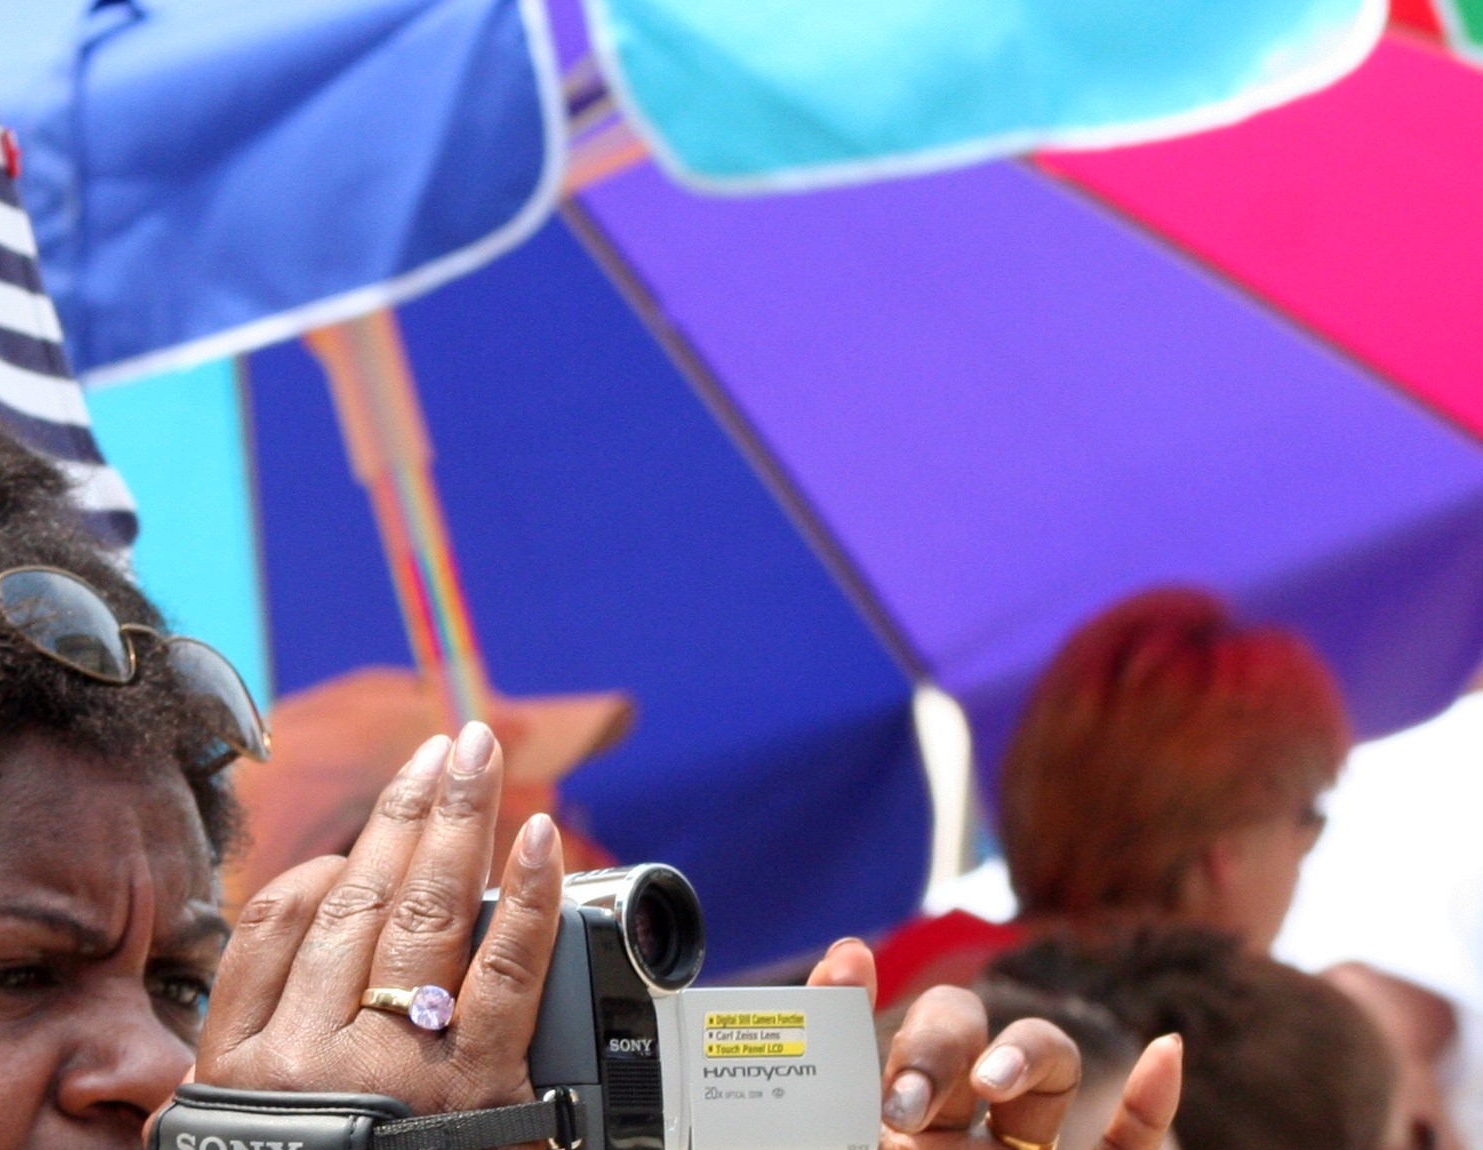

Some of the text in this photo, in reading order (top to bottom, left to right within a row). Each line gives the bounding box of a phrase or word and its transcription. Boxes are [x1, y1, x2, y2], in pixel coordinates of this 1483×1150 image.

[716, 1013, 804, 1027] Digital Still Camera Function
[716, 1030, 780, 1040] Carl Zeiss Lens
[609, 1039, 652, 1052] SONY
[716, 1043, 784, 1054] Touch Panel LCD
[703, 1064, 816, 1081] HANDYCAM
